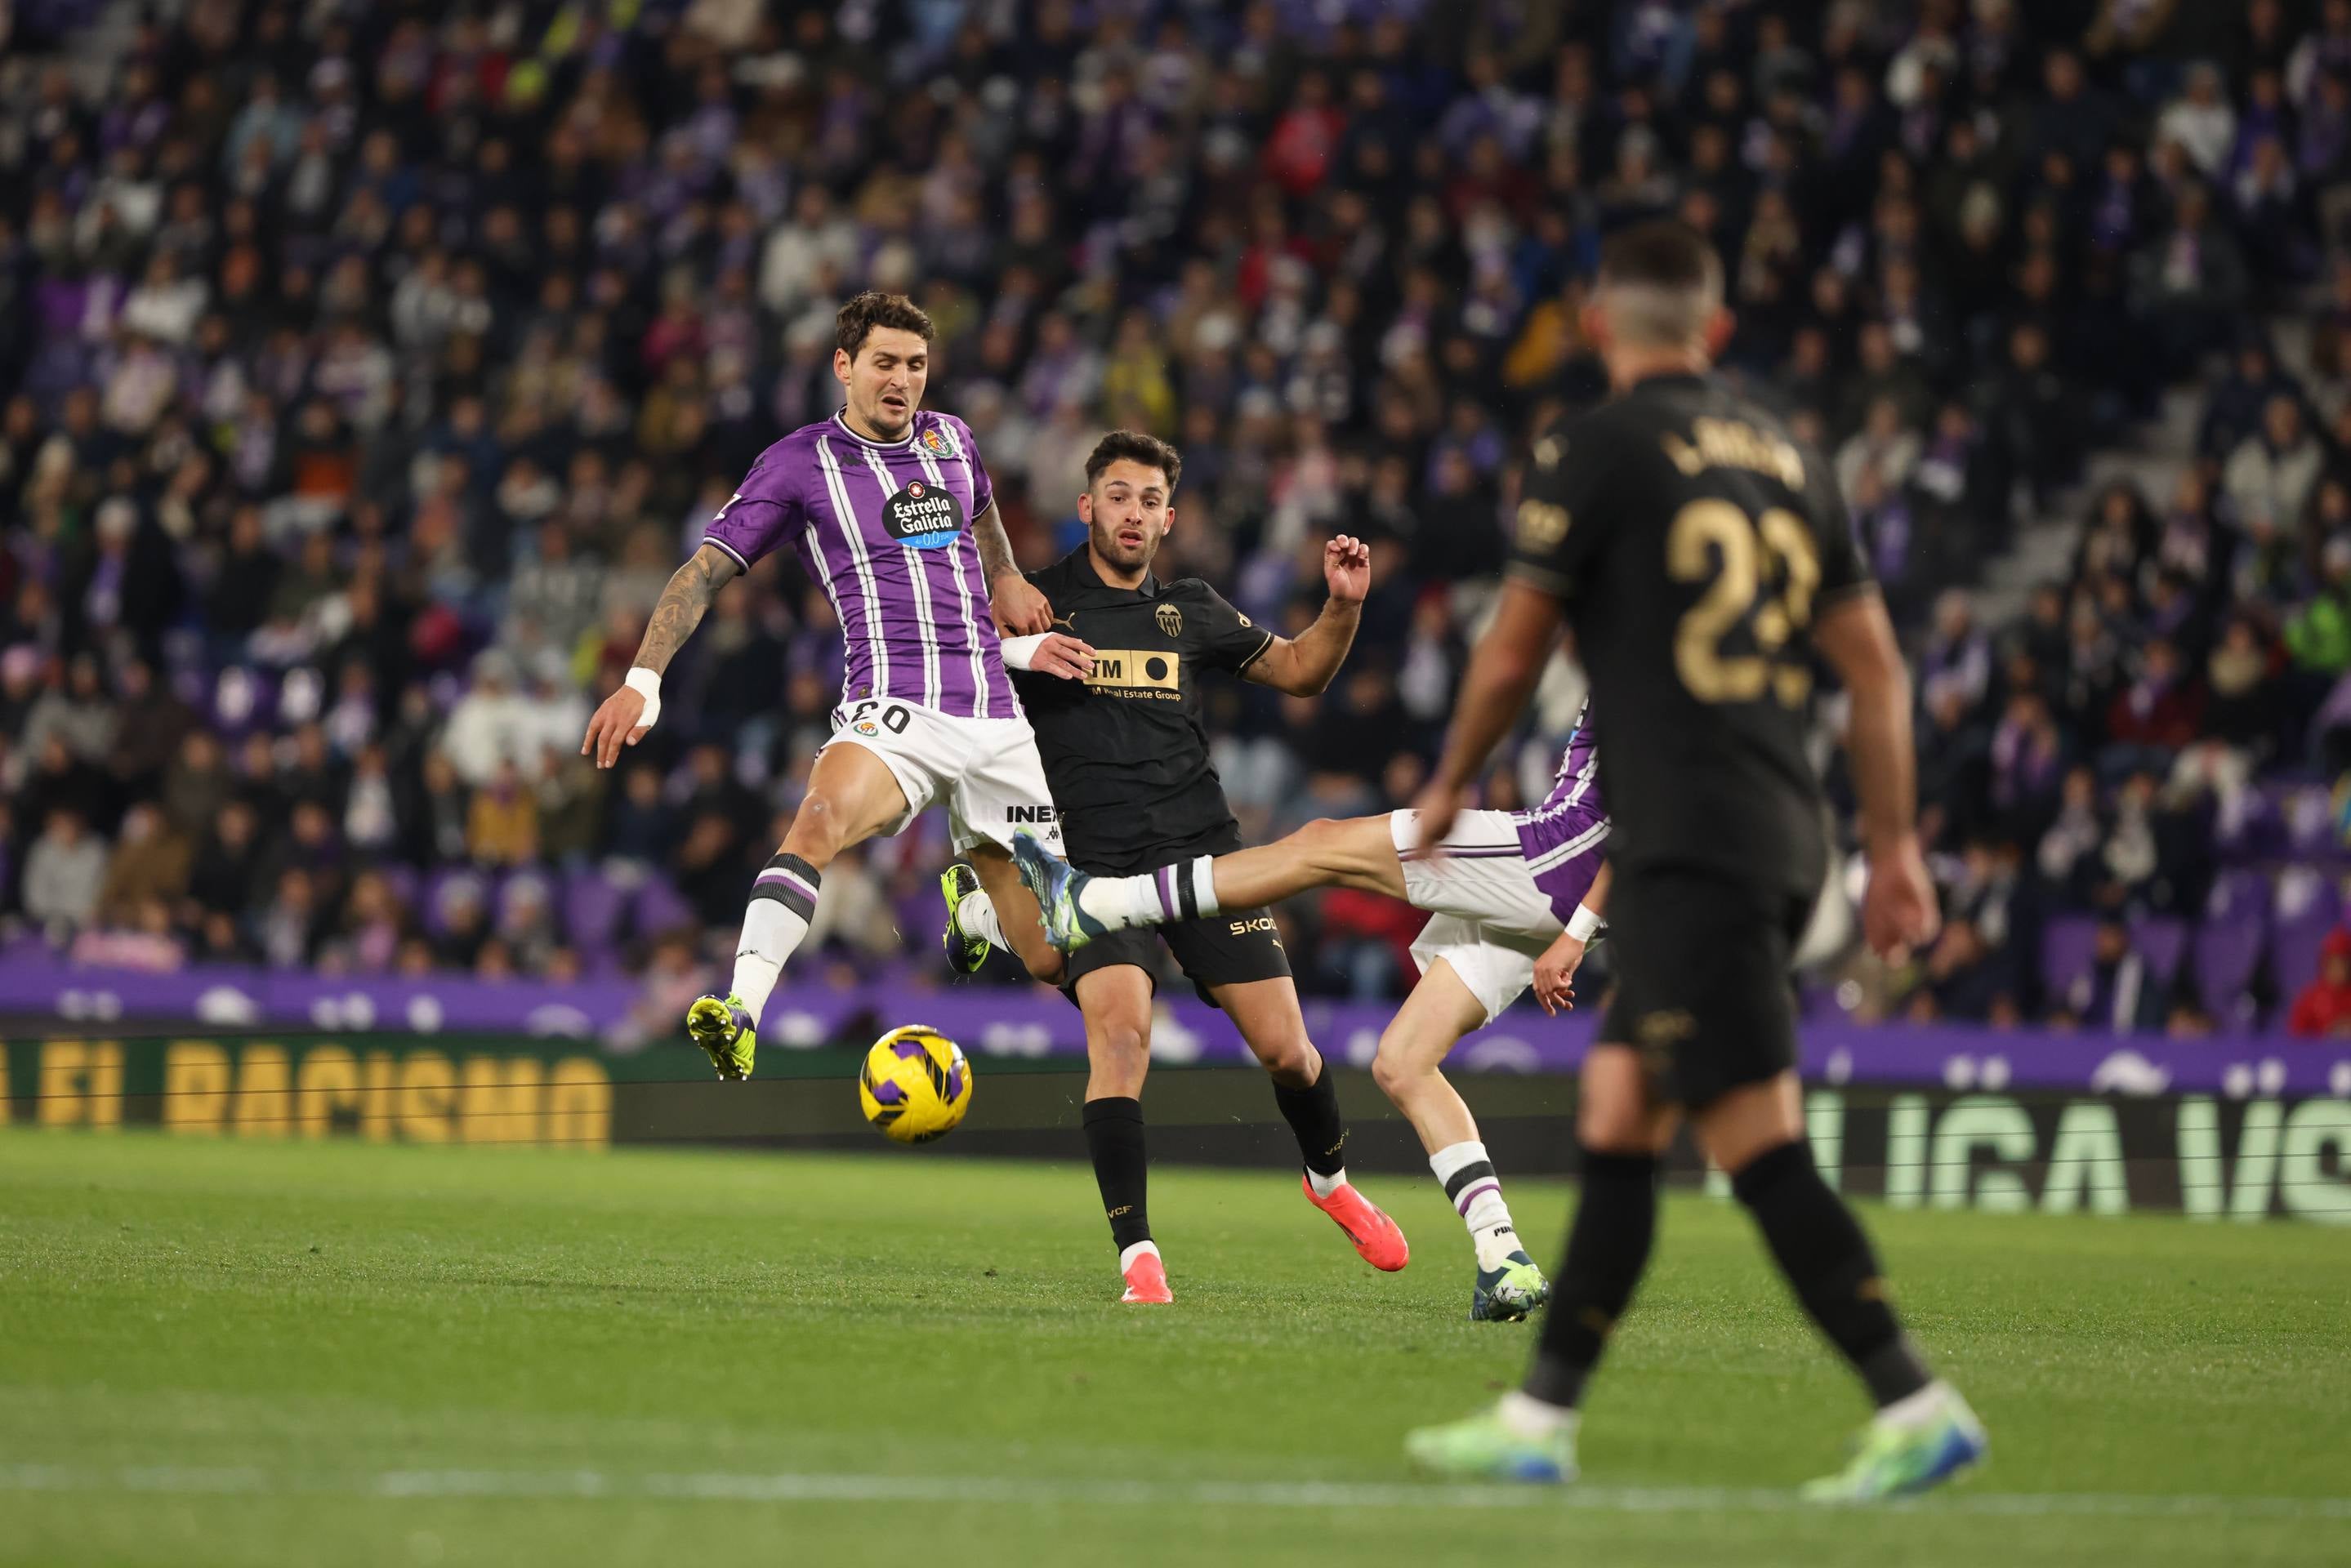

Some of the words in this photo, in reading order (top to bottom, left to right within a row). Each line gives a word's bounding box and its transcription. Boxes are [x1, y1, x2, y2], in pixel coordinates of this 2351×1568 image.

[894, 497, 951, 519] Estrella
[900, 512, 952, 533] Galicia
[1123, 690, 1153, 699] Estate
[1155, 690, 1181, 702] Group
[1108, 1205, 1134, 1218] VCF
